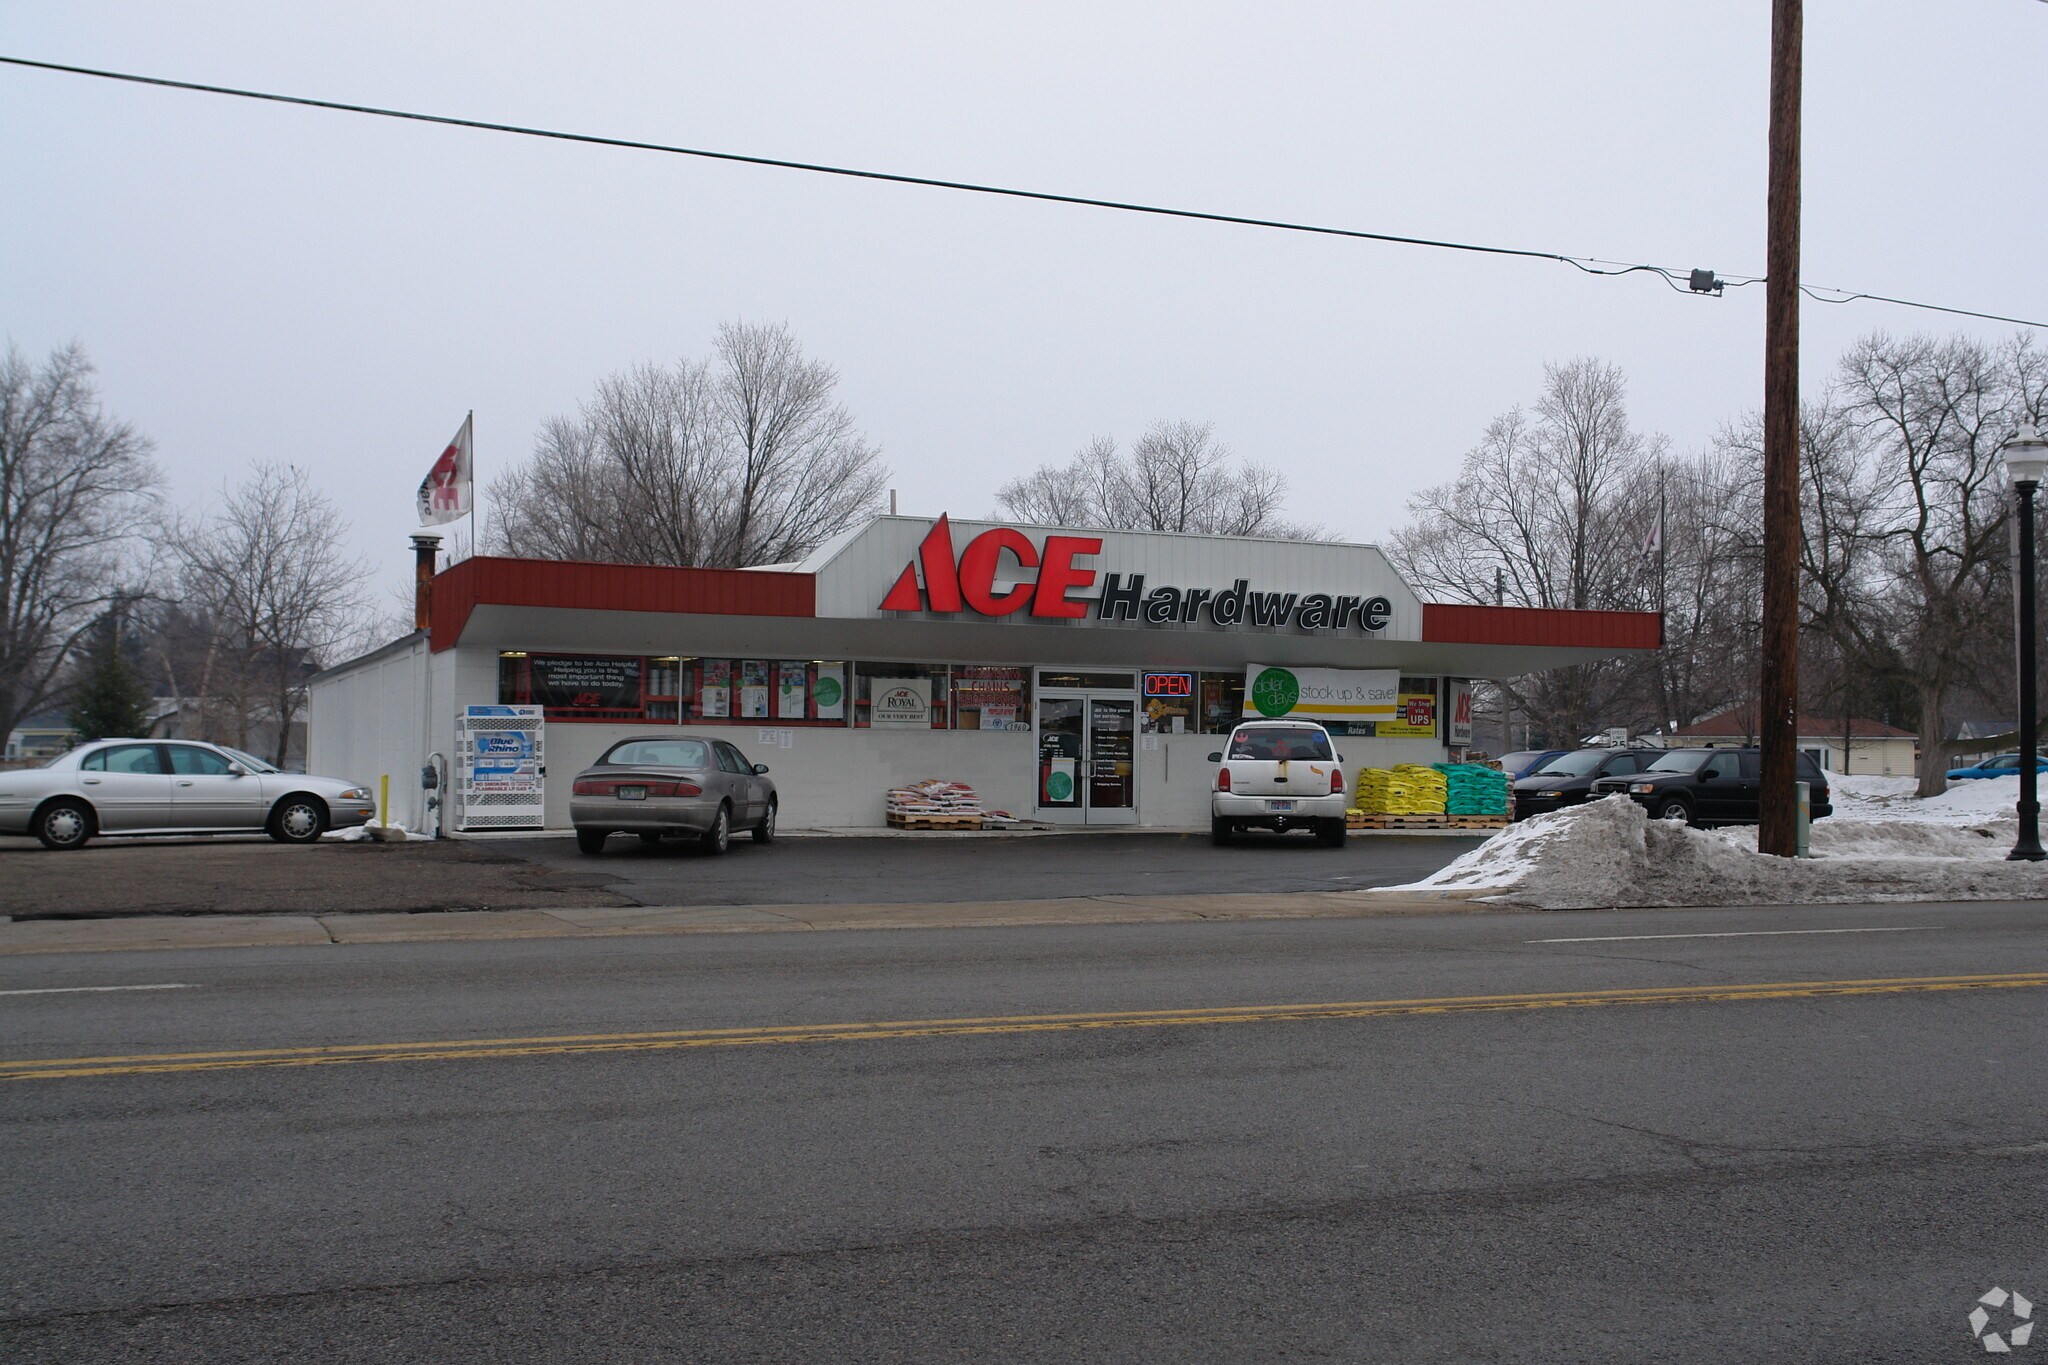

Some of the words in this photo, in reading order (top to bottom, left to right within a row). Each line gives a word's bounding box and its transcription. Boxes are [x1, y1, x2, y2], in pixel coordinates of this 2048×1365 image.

[877, 511, 1104, 618] ACE
[1098, 572, 1393, 633] Hardware
[547, 659, 573, 667] pledge
[971, 681, 1010, 692] CHAINS
[1146, 676, 1190, 694] OPEN
[1254, 677, 1285, 694] dollar
[573, 693, 601, 704] ACE
[1267, 692, 1297, 706] days
[1300, 685, 1334, 699] stock
[1336, 689, 1353, 702] up
[1355, 686, 1366, 700] &
[1368, 685, 1397, 700] save!
[887, 697, 917, 708] ROYAL
[1418, 700, 1430, 708] Ship
[1410, 714, 1430, 725] UPS
[1347, 727, 1367, 735] Rates
[488, 745, 519, 753] Rhino
[1612, 740, 1626, 748] 25
